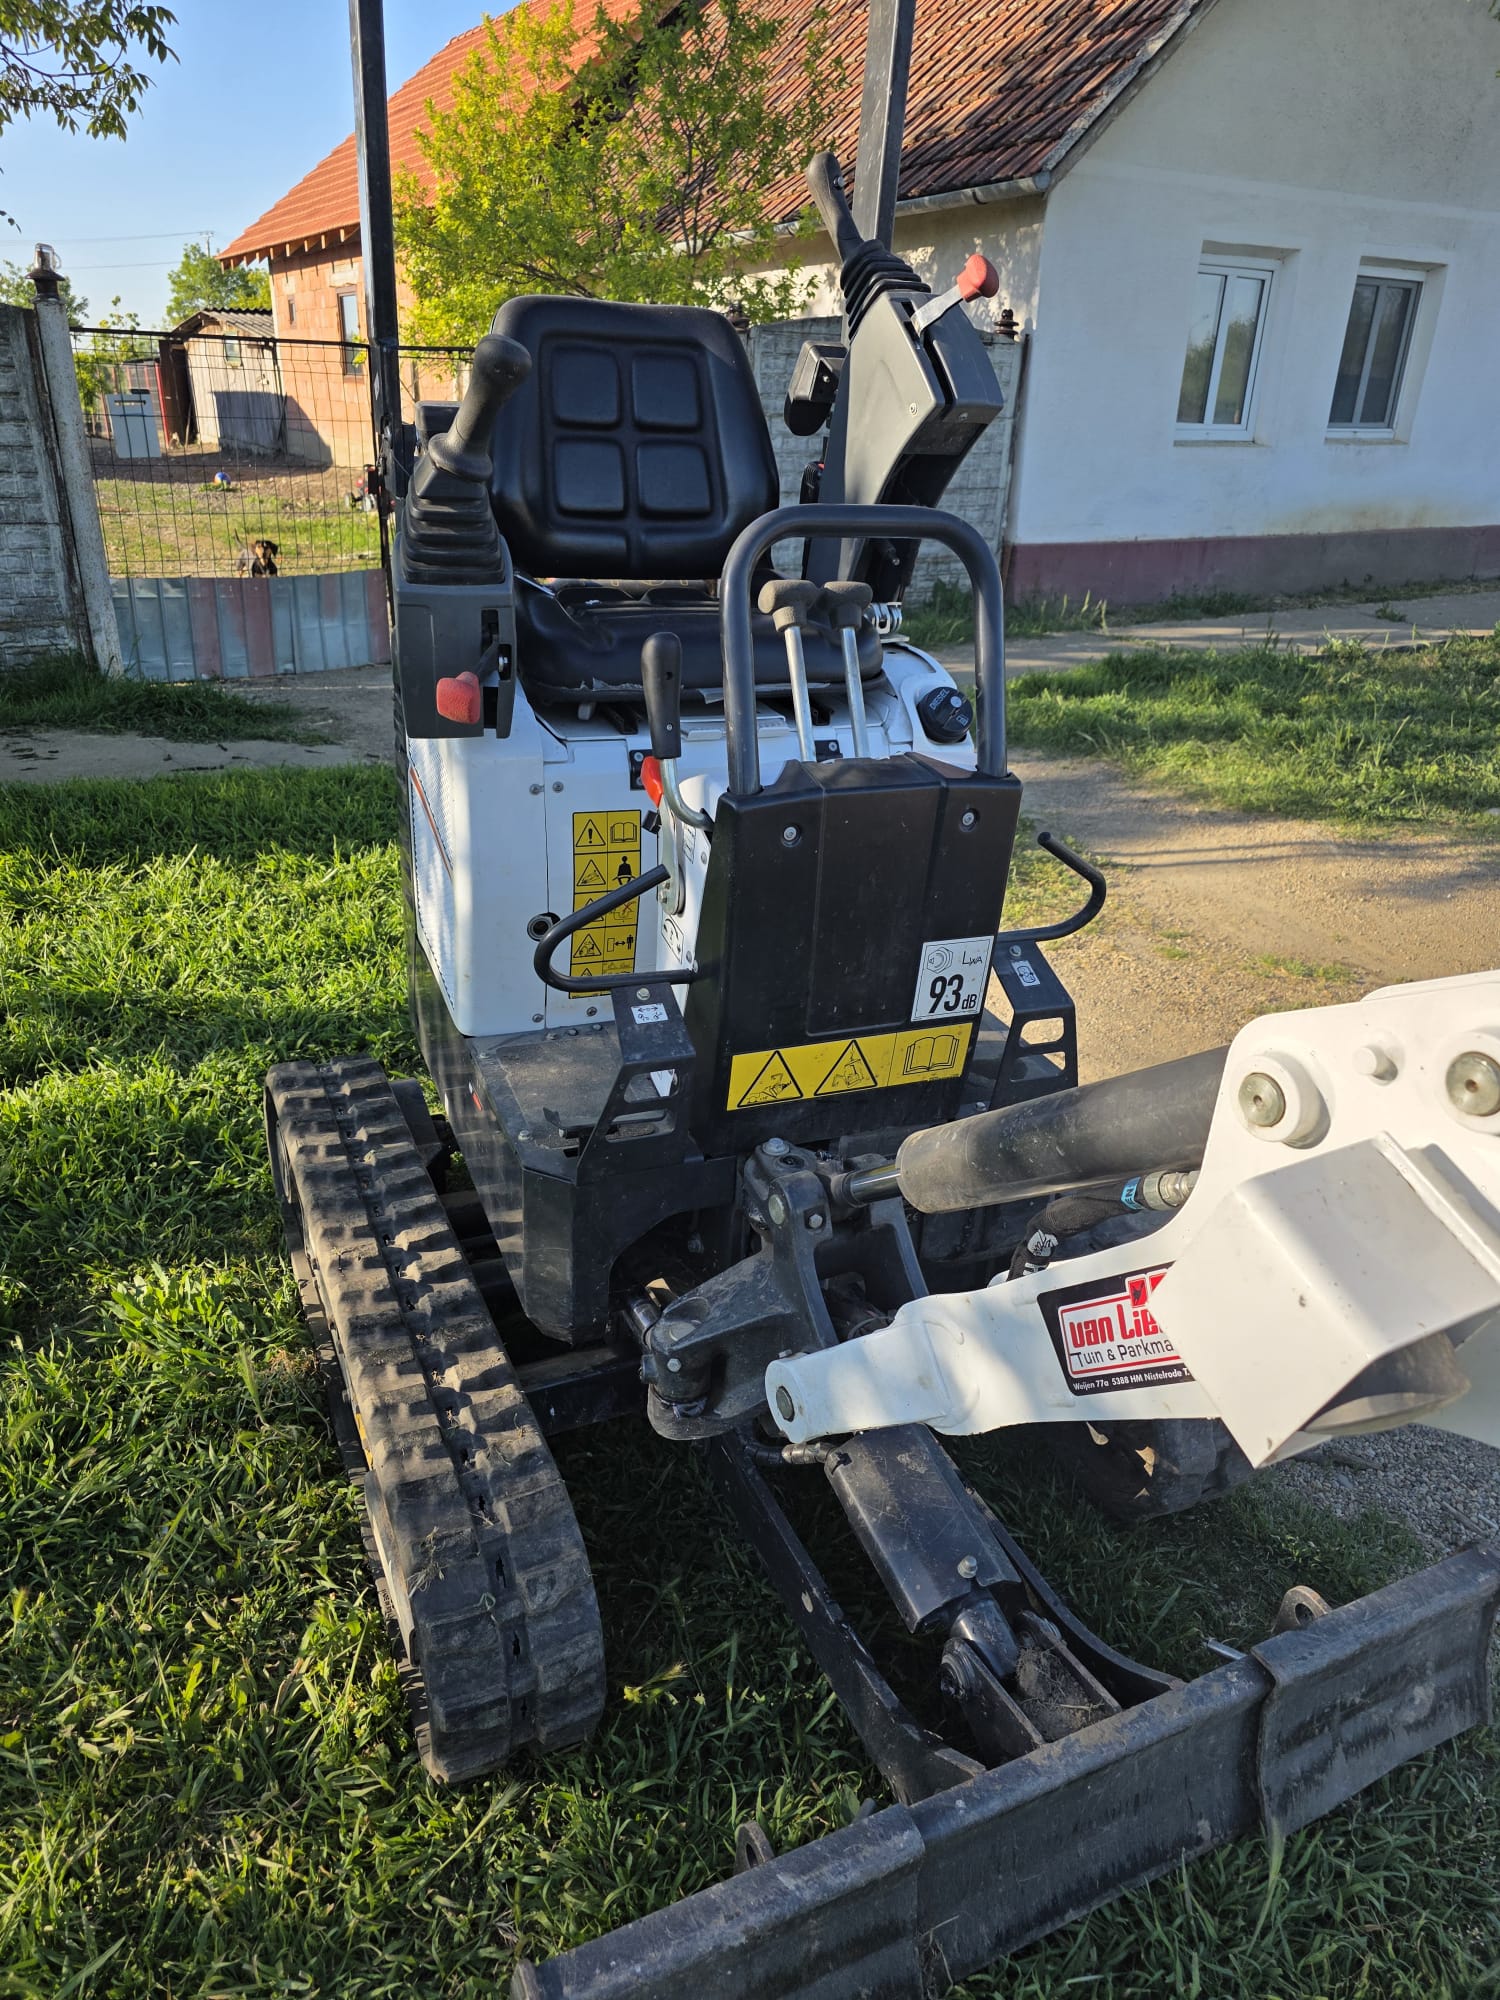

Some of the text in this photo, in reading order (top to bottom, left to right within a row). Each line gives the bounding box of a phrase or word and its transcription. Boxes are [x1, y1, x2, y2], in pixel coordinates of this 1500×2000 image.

[928, 974, 977, 1014] 93 dB
[1069, 1303, 1164, 1348] van Lie
[1070, 1350, 1104, 1367] Tuin
[1107, 1349, 1116, 1361] &
[1111, 1376, 1129, 1386] 5388
[1129, 1373, 1143, 1383] HM
[1144, 1368, 1182, 1381] Nistelrode
